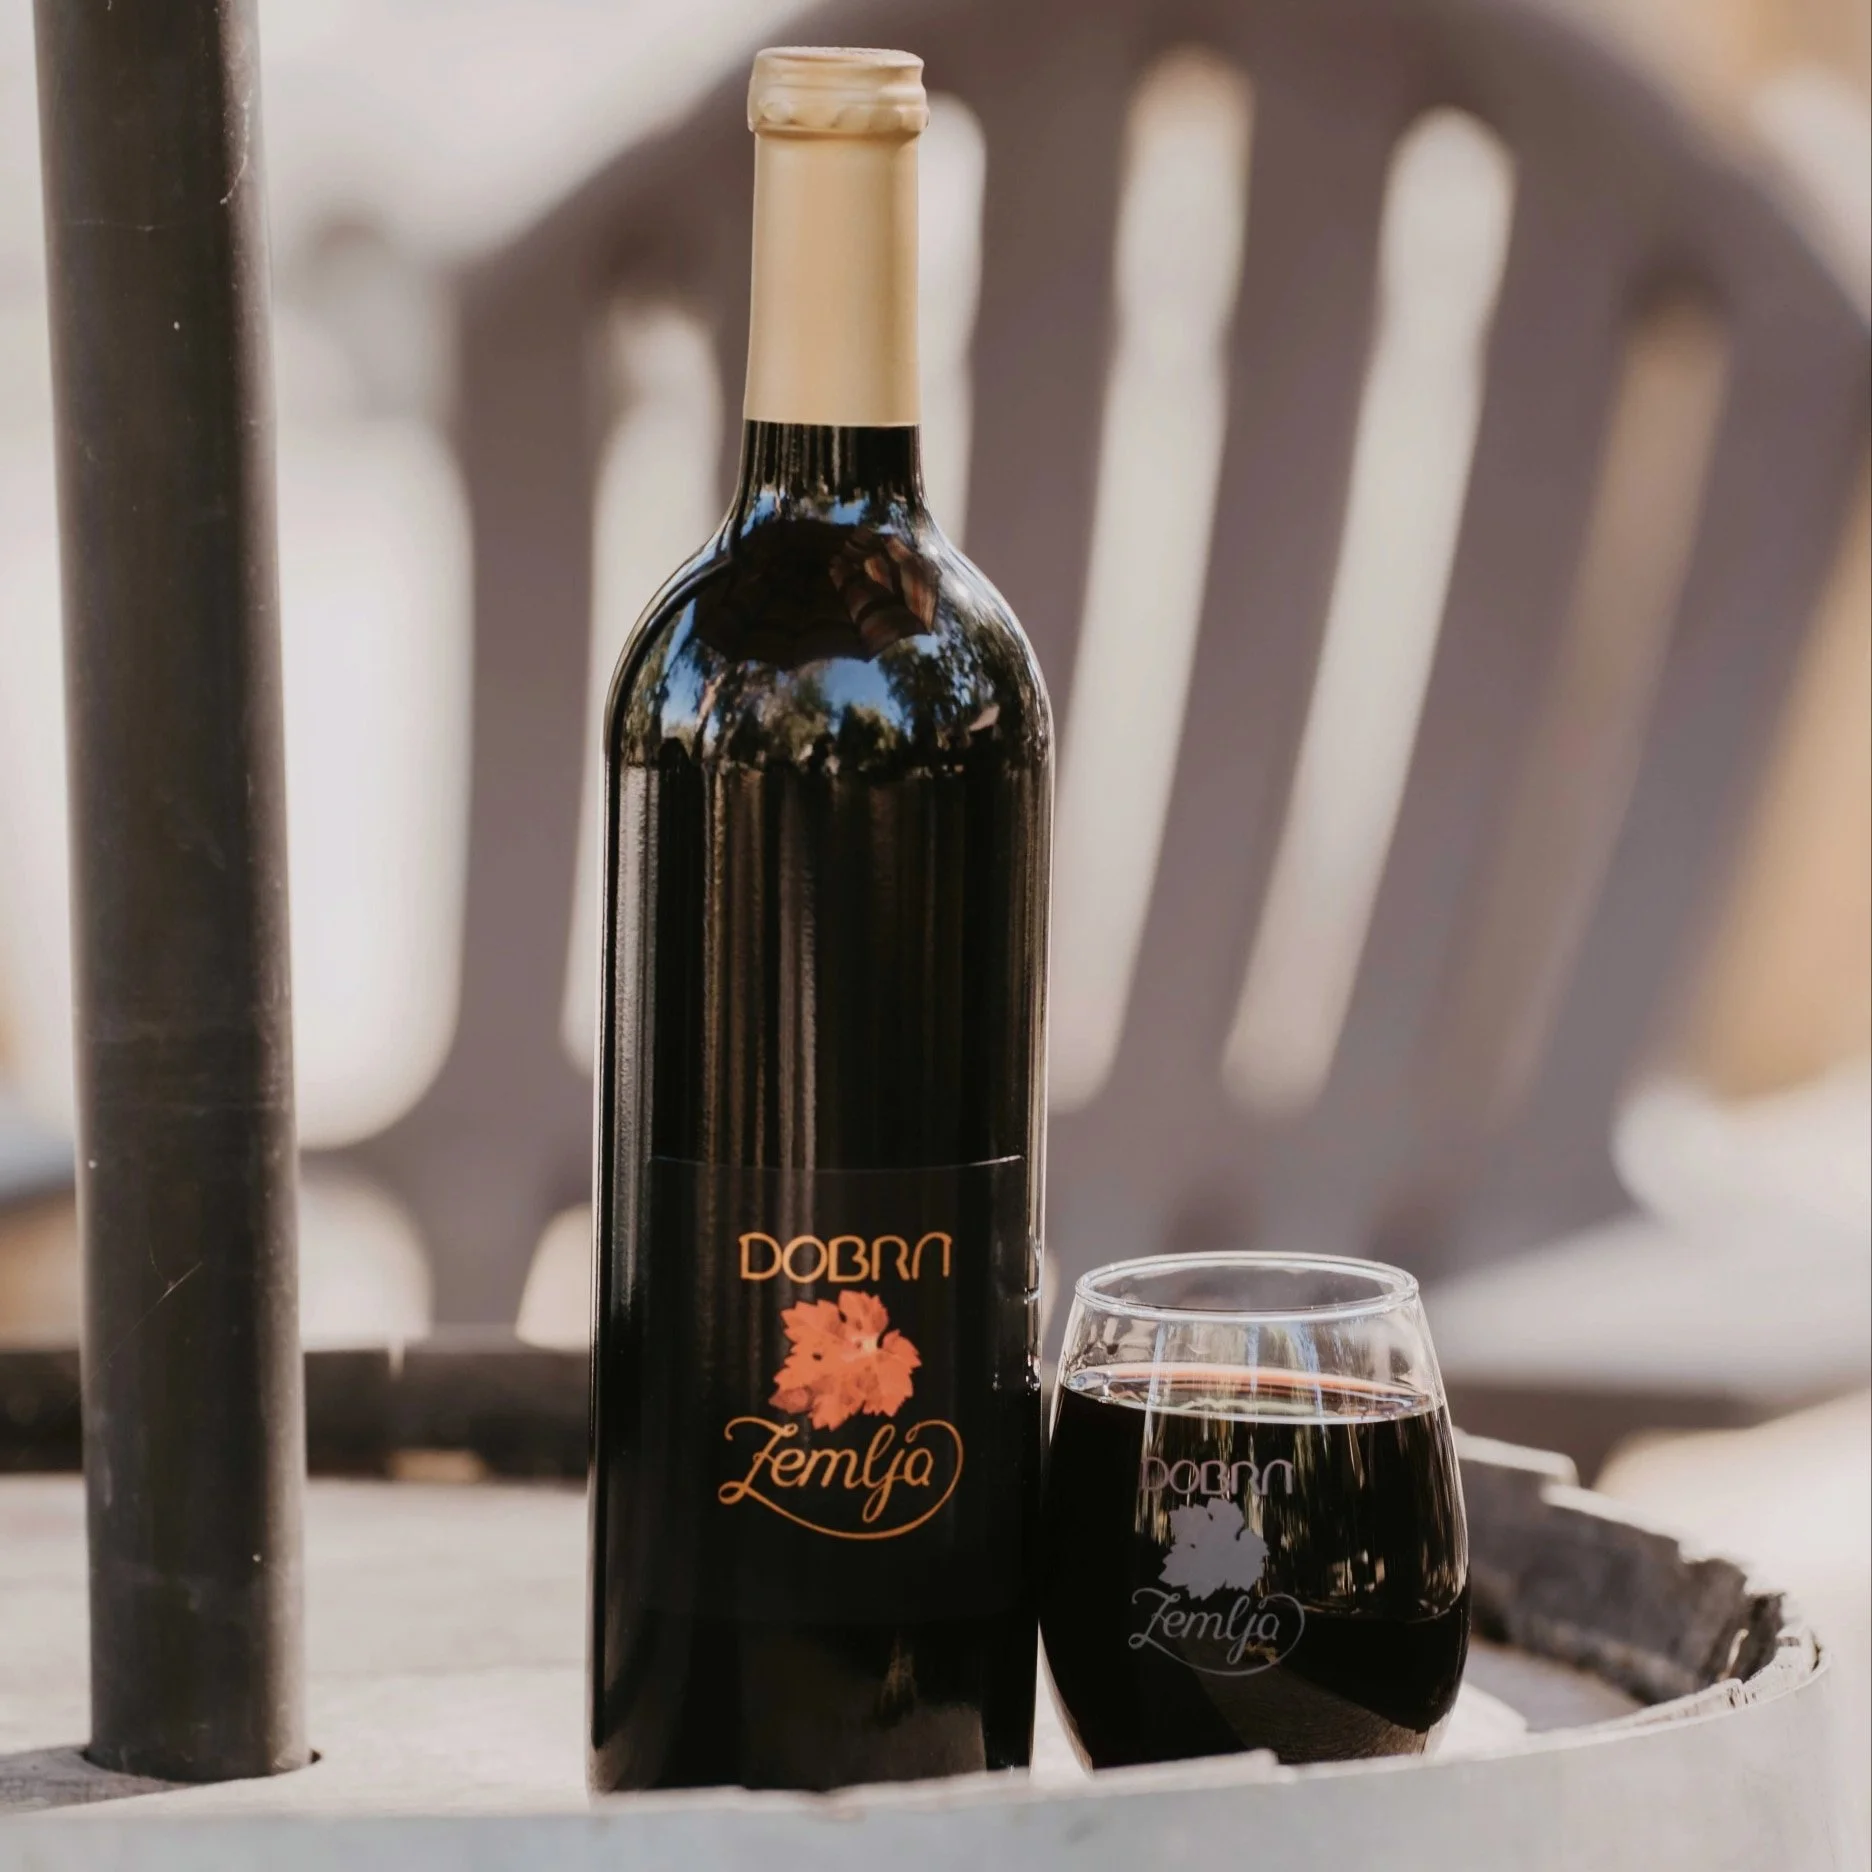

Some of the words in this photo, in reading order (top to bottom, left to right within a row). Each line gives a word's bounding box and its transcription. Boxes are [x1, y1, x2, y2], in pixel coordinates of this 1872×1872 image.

[738, 1231, 953, 1284] DOBRA
[718, 1416, 964, 1540] Zemlja
[1140, 1456, 1294, 1496] DOBRA
[1128, 1587, 1306, 1676] Zemlja
